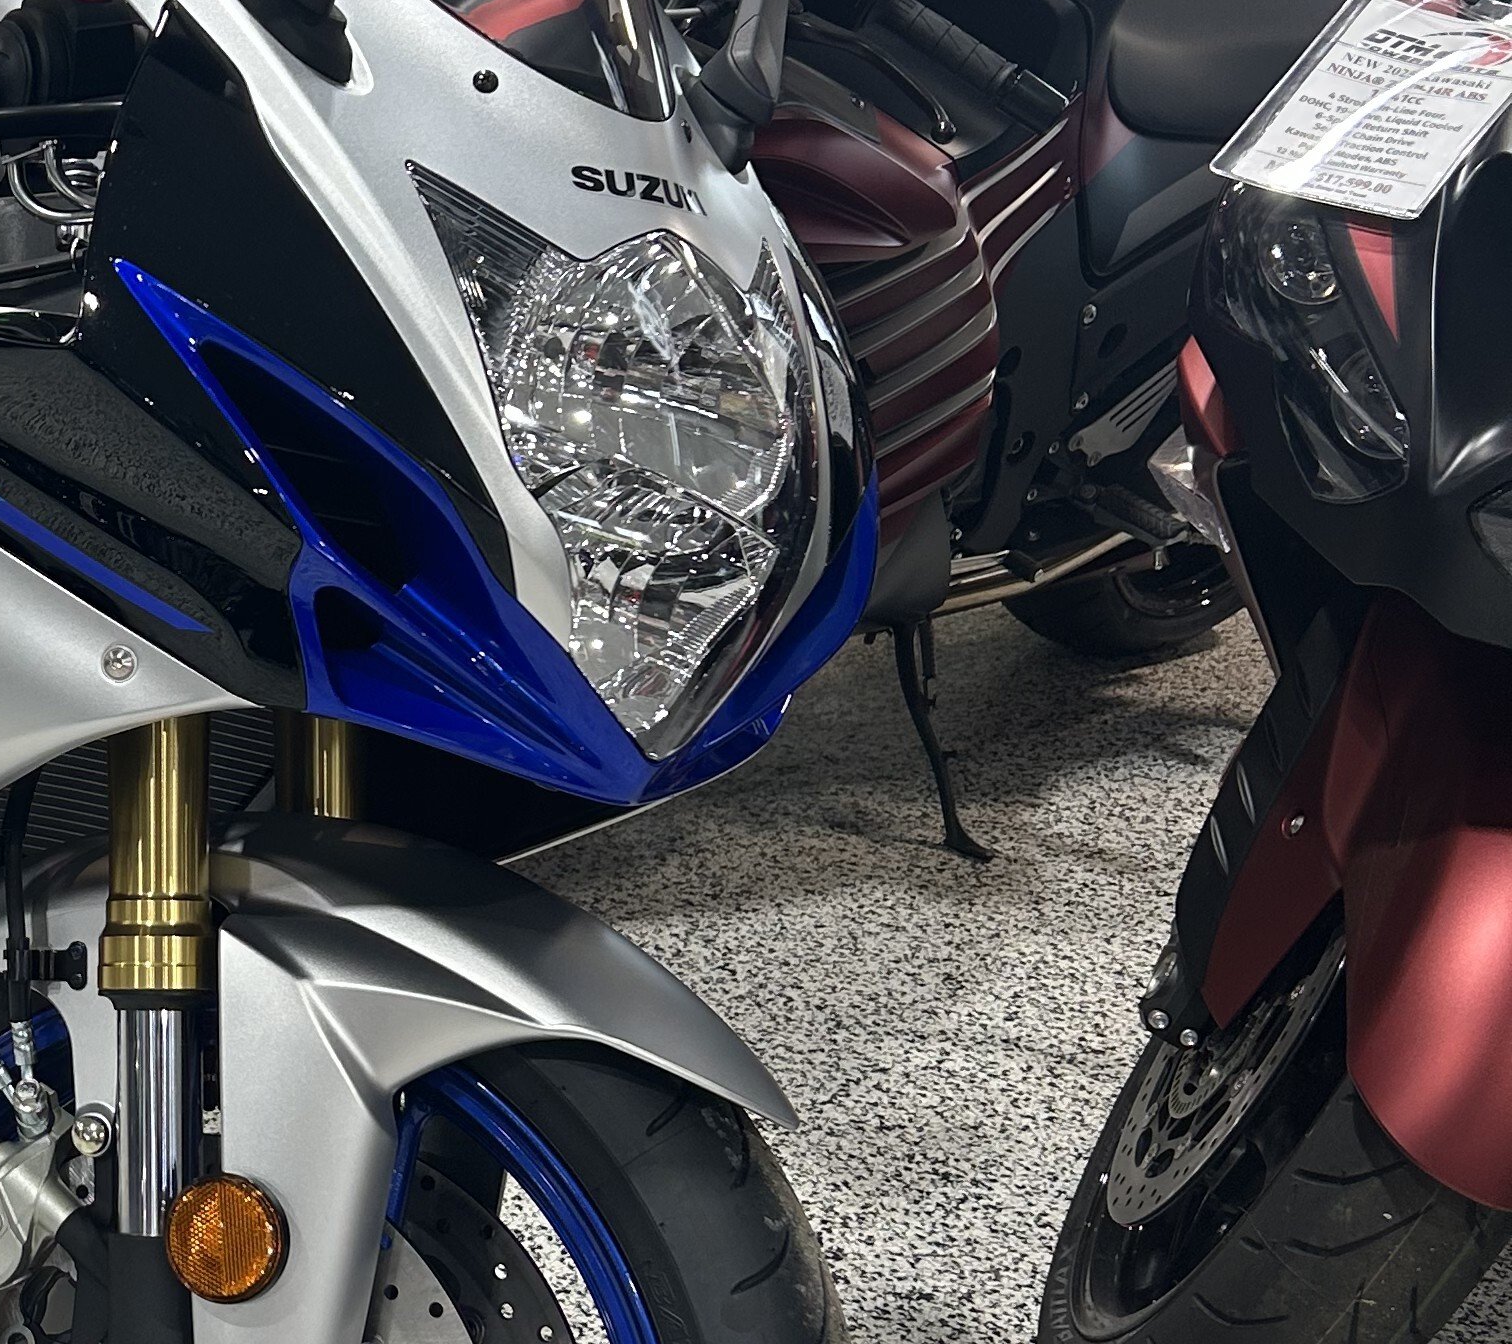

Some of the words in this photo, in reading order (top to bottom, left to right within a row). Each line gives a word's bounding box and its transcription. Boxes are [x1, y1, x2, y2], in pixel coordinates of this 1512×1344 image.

[1343, 52, 1383, 70] NEW
[1454, 90, 1489, 102] ABS
[1298, 94, 1333, 112] DOHC,
[1421, 119, 1464, 133] Cooled
[1362, 122, 1402, 135] Return
[1351, 131, 1385, 143] Chain
[1385, 146, 1429, 161] Control
[1374, 156, 1399, 167] ABS
[1360, 164, 1409, 180] Warranty
